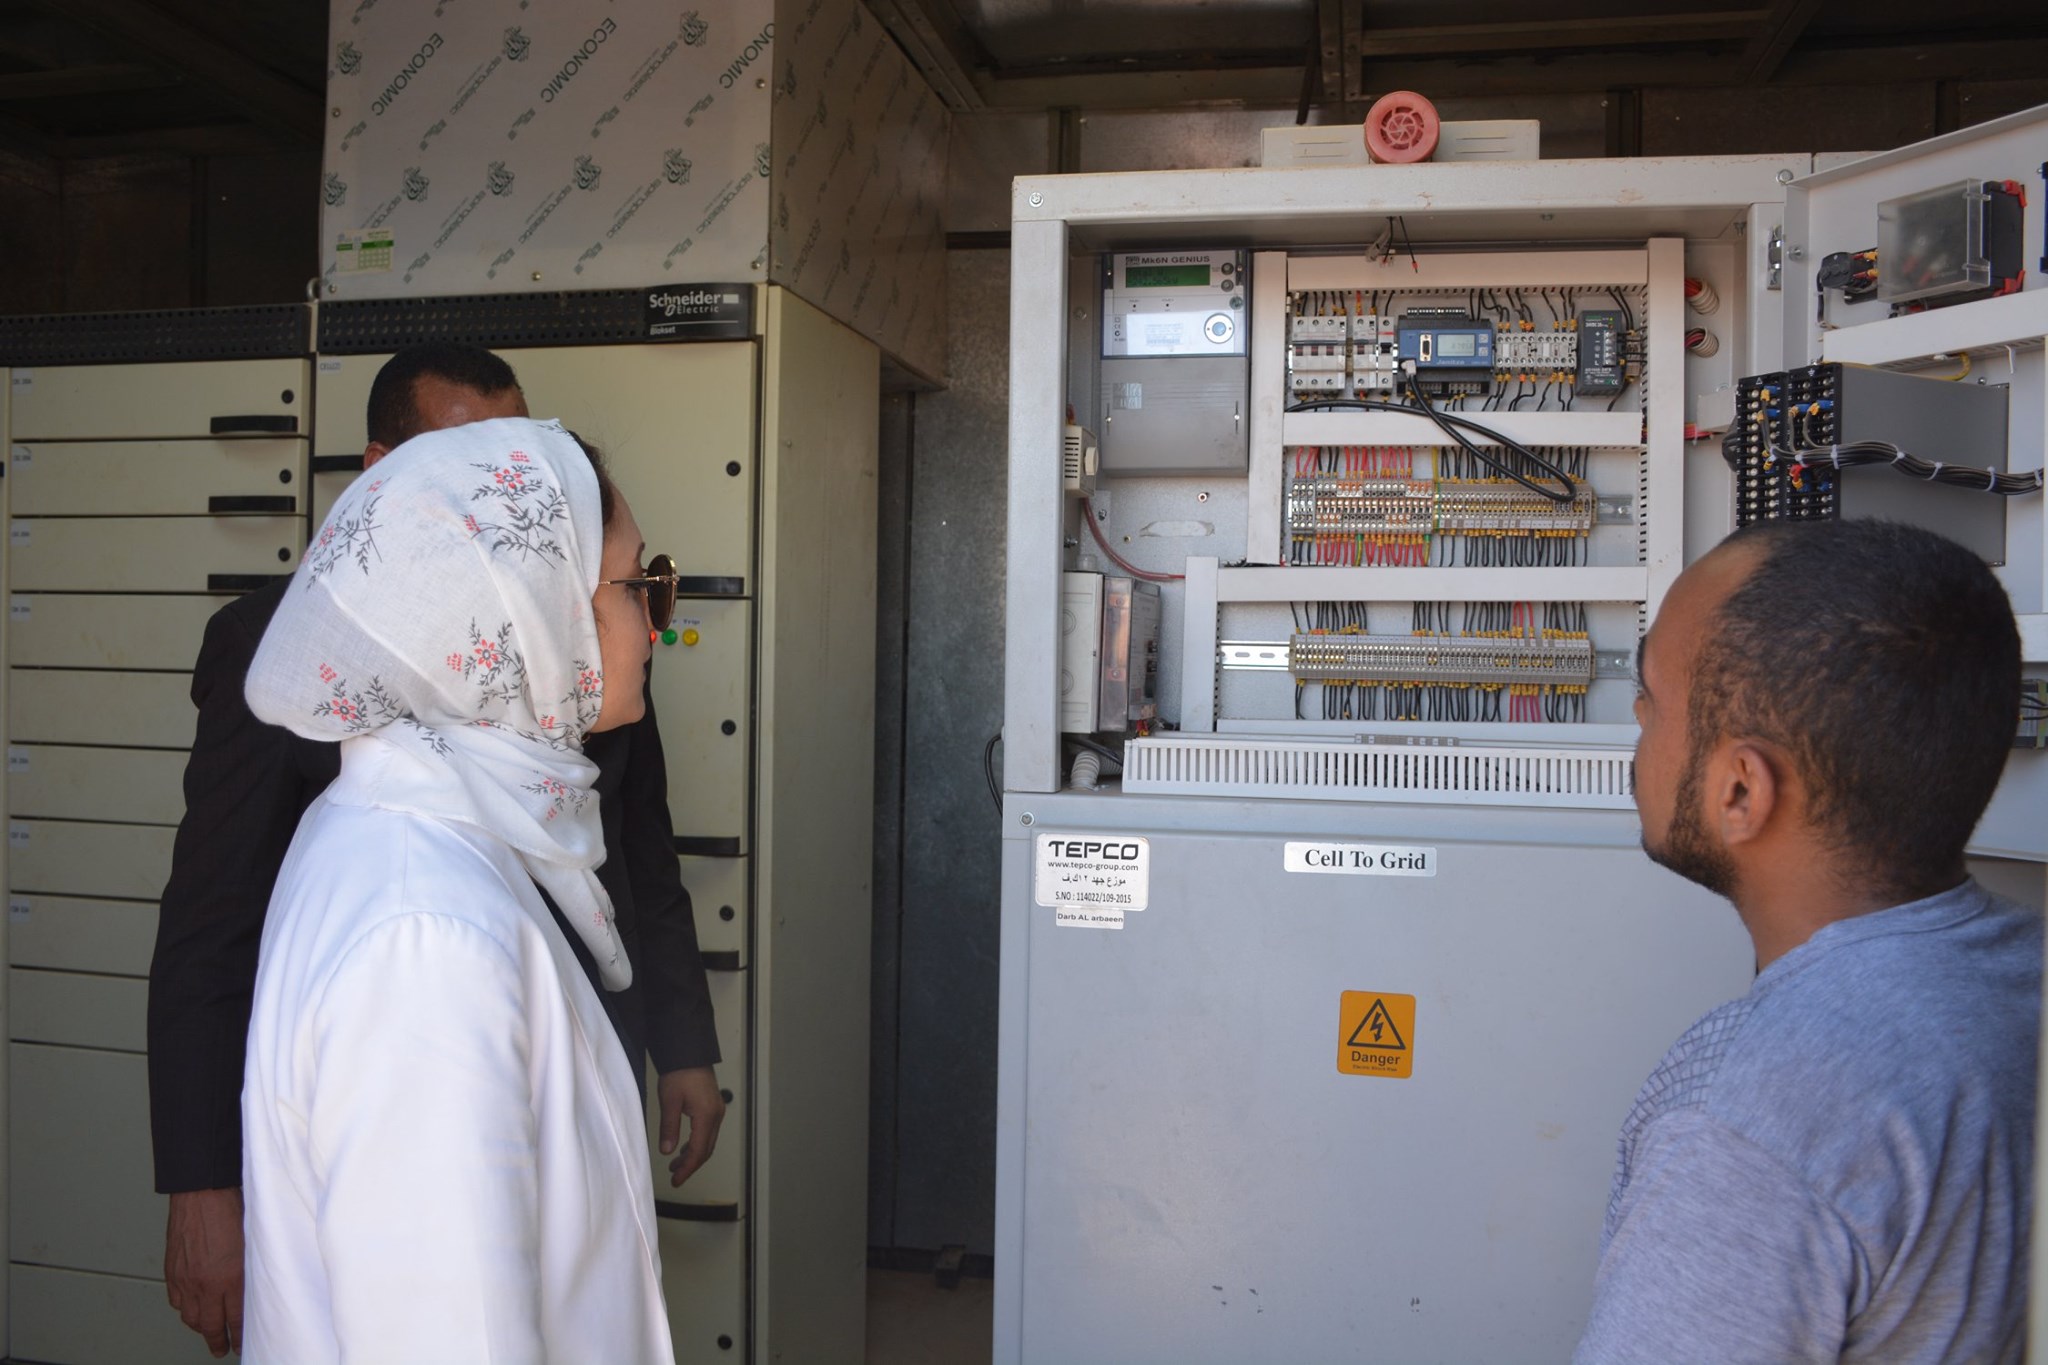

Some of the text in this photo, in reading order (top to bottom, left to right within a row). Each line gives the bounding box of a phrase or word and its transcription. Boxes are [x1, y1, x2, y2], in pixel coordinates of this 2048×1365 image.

[540, 16, 617, 104] ECONOMIC
[371, 32, 444, 117] ECONOMIC
[1141, 257, 1168, 265] Mk6N
[1171, 255, 1210, 264] GENIUS
[649, 290, 721, 308] Schneider
[676, 305, 720, 315] Electric
[1049, 840, 1139, 860] TEPCO
[1304, 847, 1427, 871] Cell To Grid
[1048, 861, 1139, 871] www.tepco-group.com
[1351, 1050, 1400, 1067] Danger
